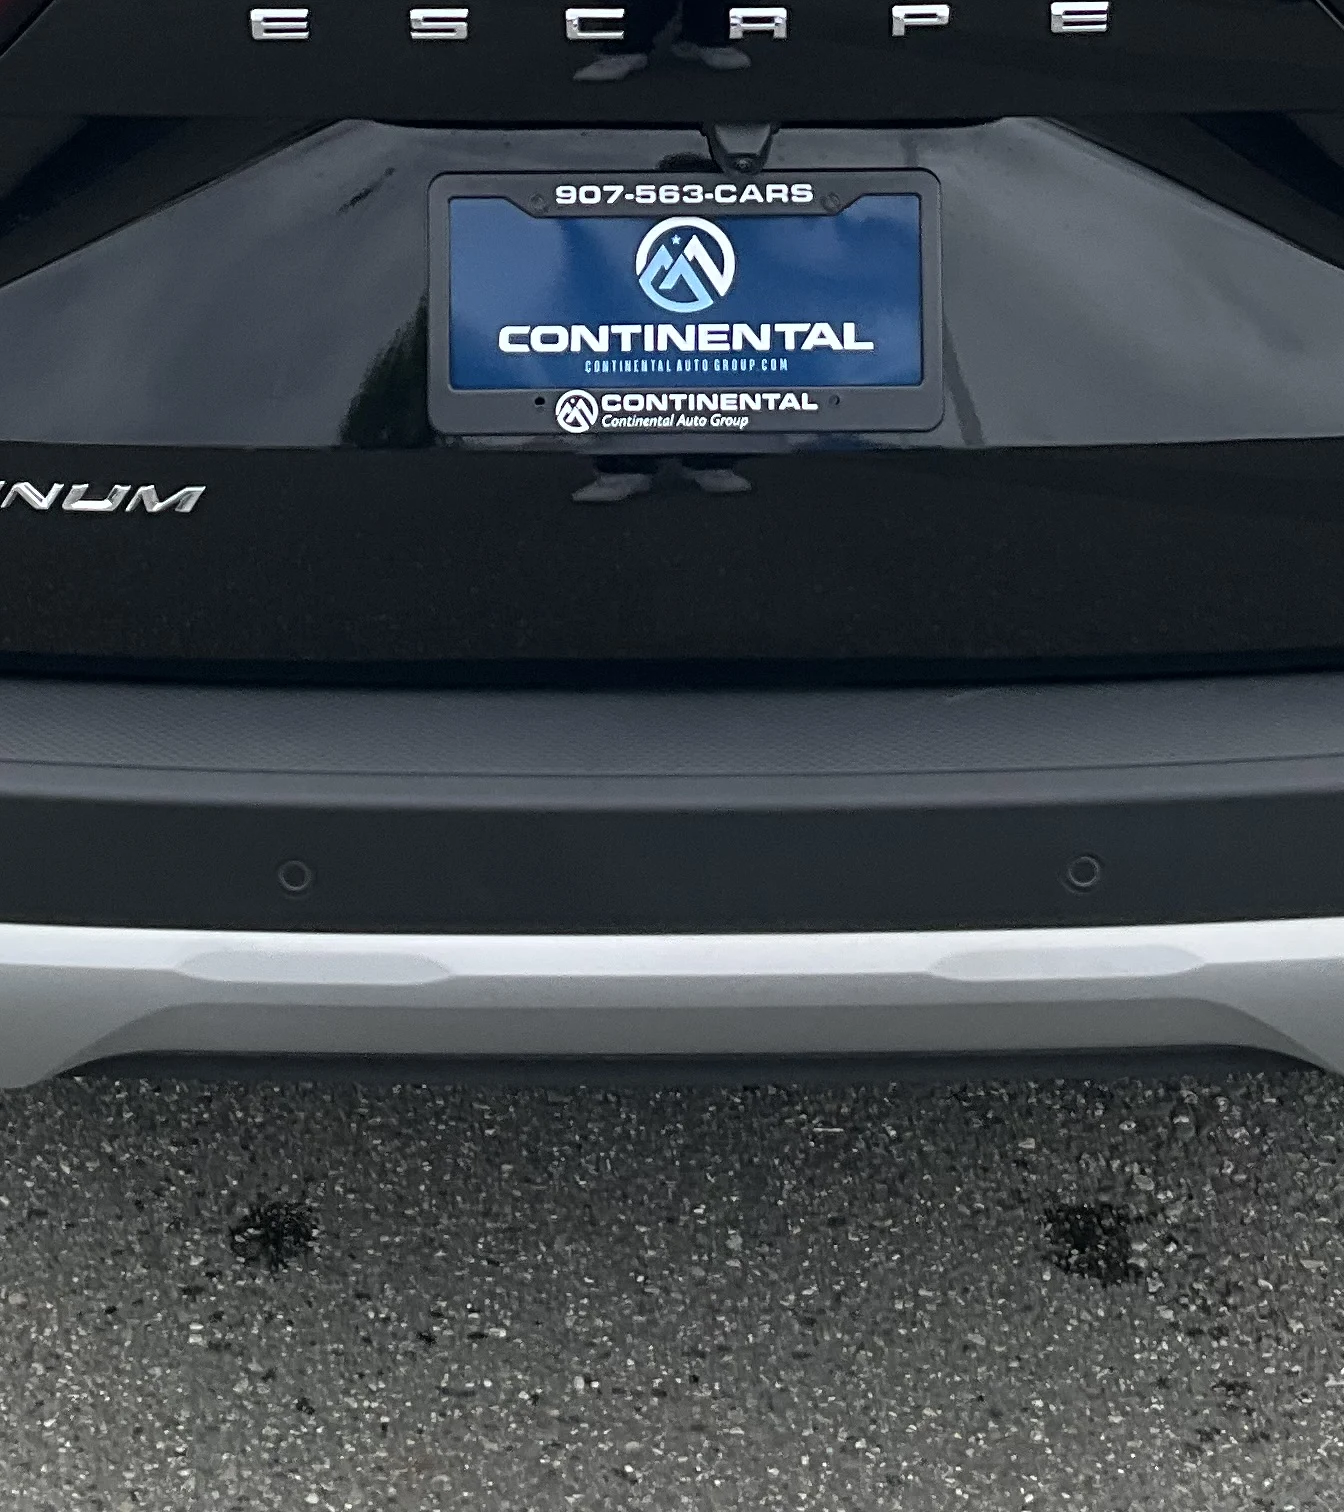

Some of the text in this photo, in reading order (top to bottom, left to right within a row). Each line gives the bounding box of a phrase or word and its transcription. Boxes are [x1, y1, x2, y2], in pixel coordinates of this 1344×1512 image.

[250, 0, 1111, 40] ESCAPE
[555, 183, 814, 204] 907-563-CARS
[498, 322, 874, 353] CONTINENTAL
[601, 392, 819, 412] CONTINENTAL
[601, 413, 749, 430] Continental Auto Group
